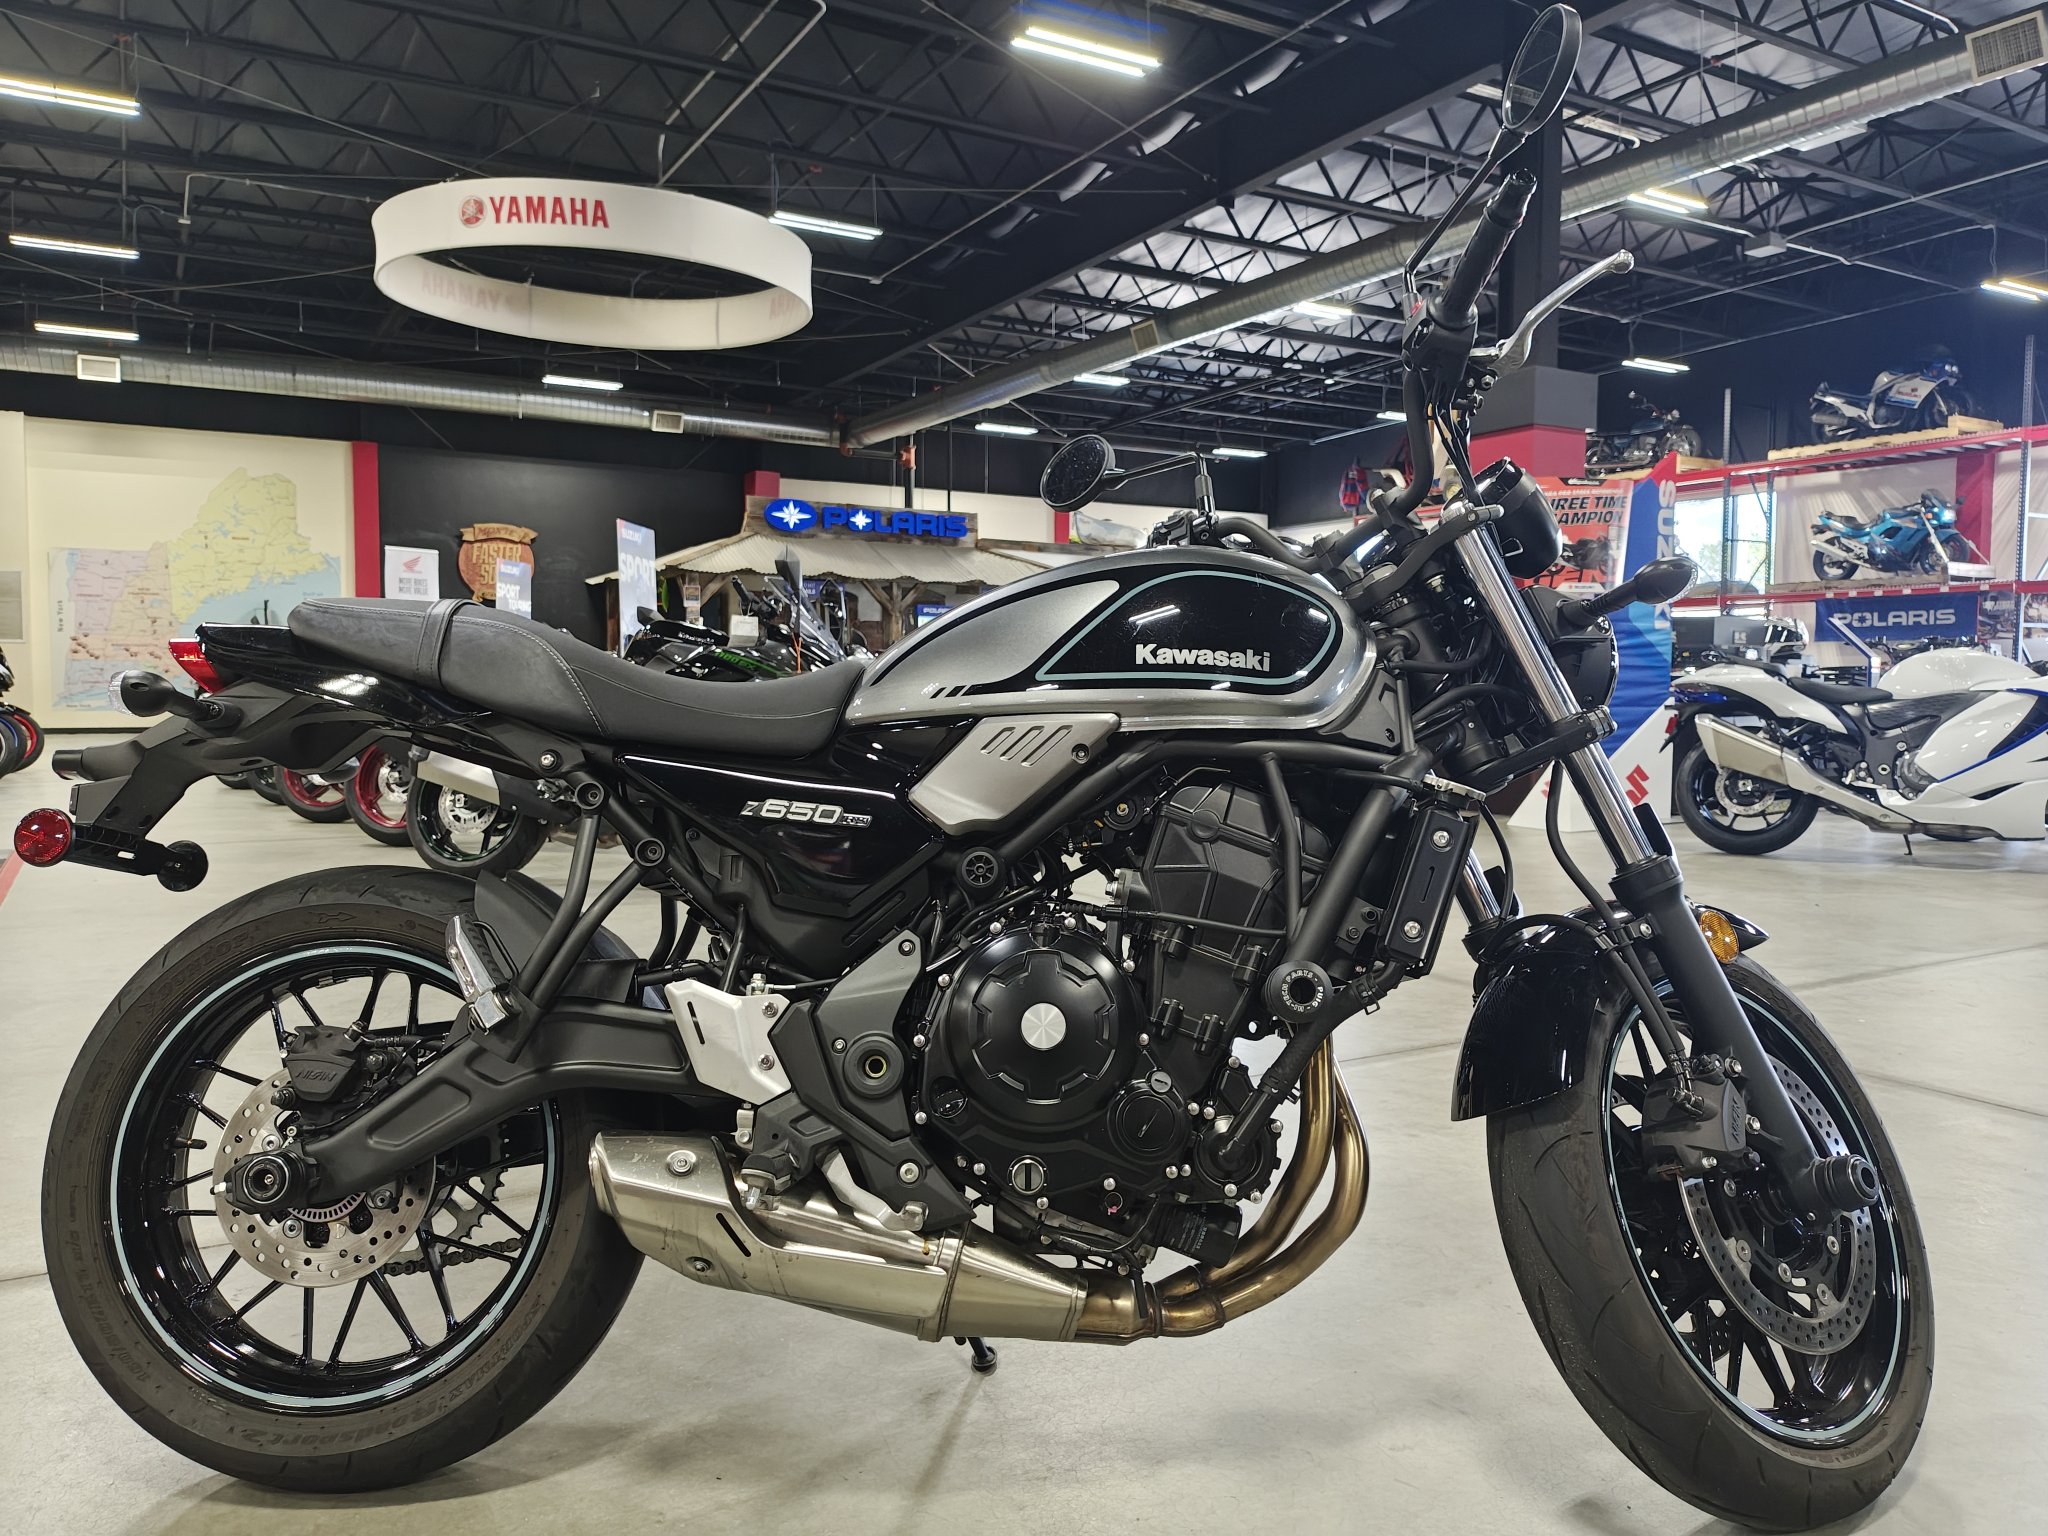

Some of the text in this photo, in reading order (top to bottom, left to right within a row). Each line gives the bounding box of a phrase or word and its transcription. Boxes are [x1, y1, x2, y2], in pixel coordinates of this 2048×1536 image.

[489, 195, 610, 229] YAMAHA
[1594, 496, 1628, 509] TIME
[822, 506, 968, 538] POLARIS
[472, 543, 522, 563] FASTER
[1653, 479, 1677, 630] SUZKI
[620, 553, 656, 587] SPORT
[497, 582, 521, 600] SPORT
[1135, 643, 1271, 672] Kawasaki
